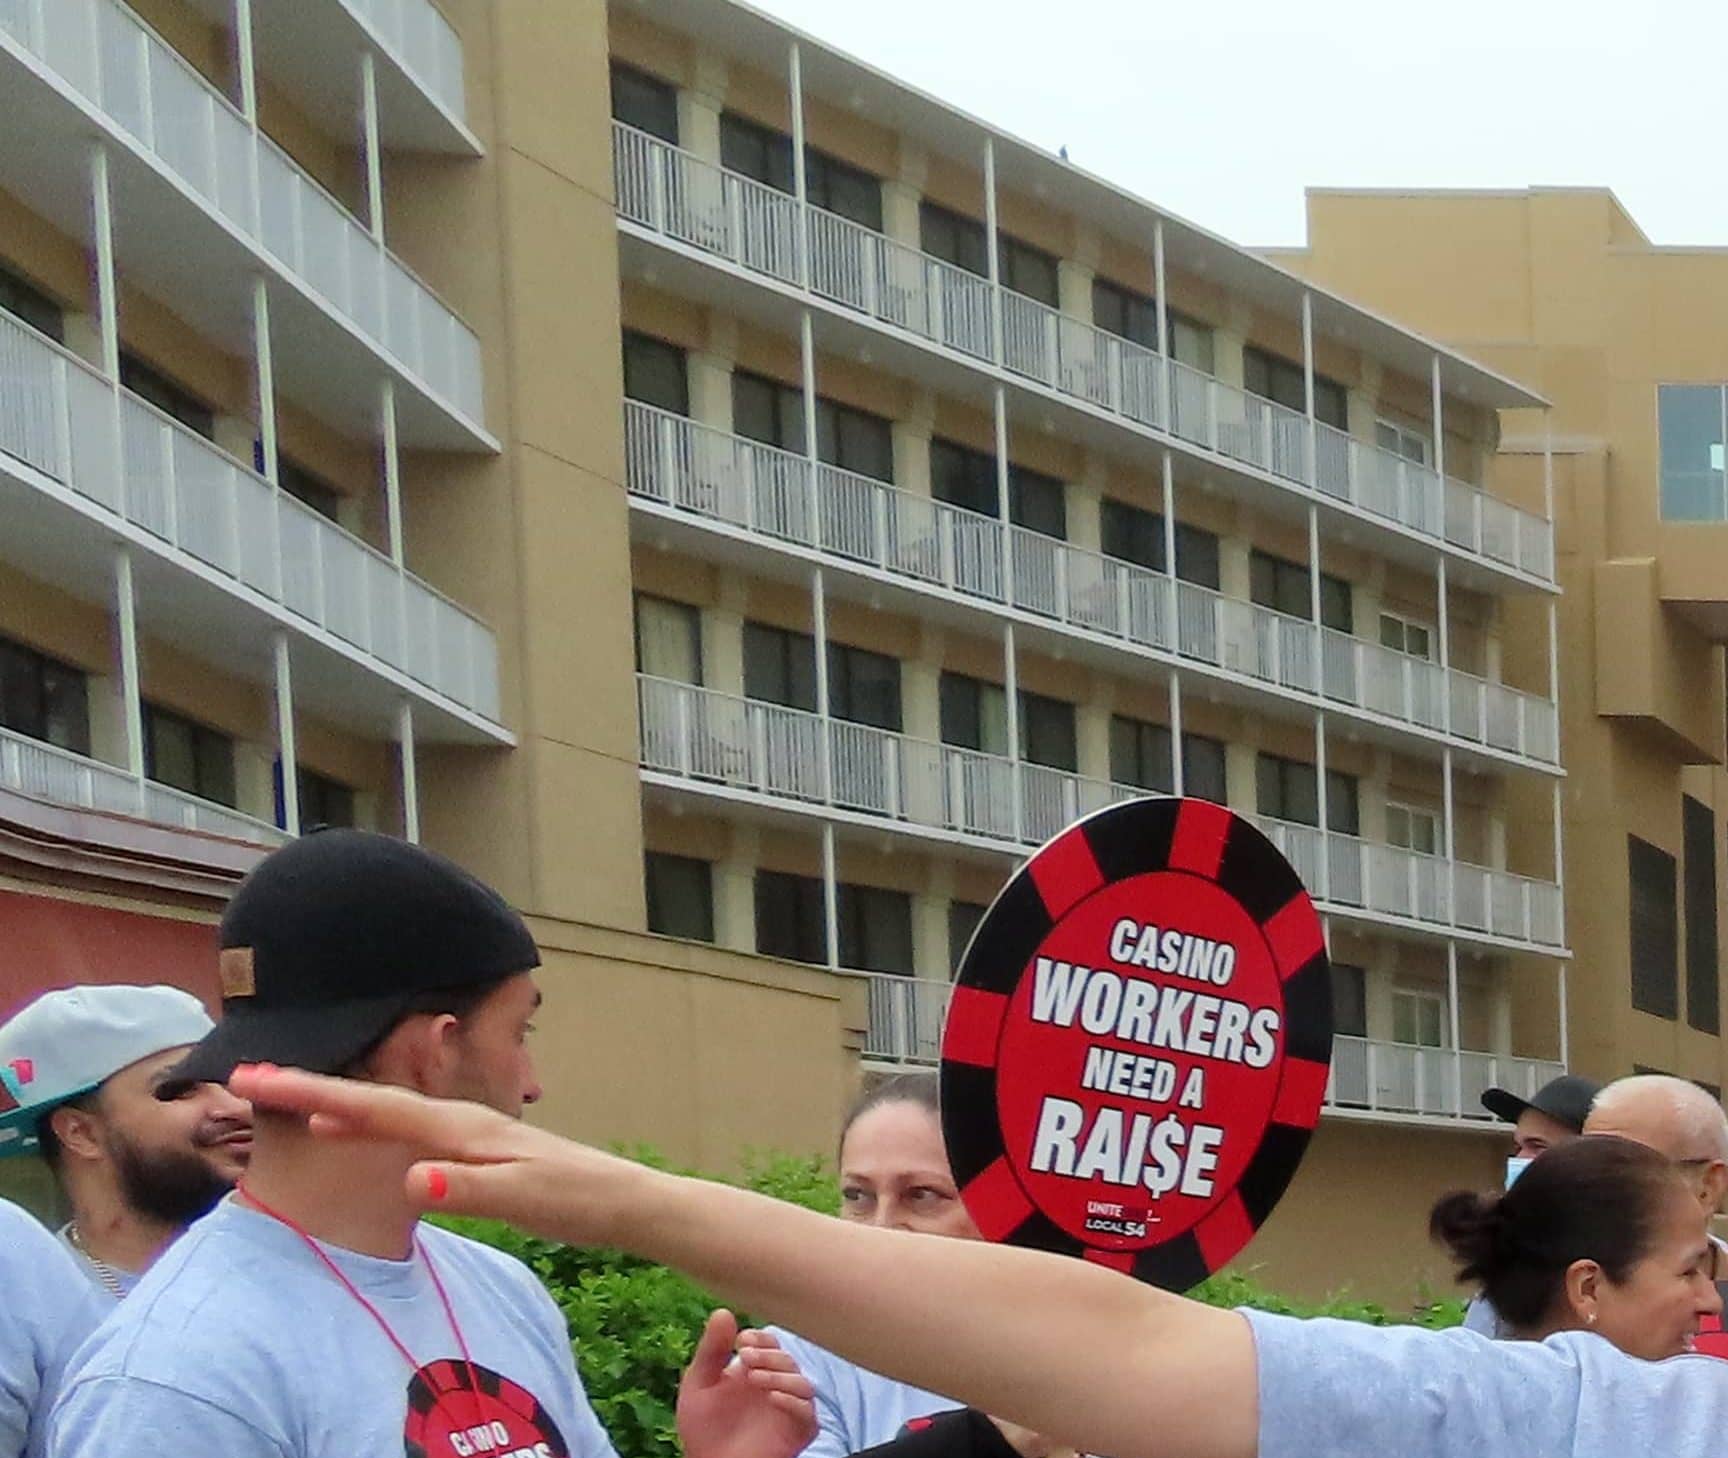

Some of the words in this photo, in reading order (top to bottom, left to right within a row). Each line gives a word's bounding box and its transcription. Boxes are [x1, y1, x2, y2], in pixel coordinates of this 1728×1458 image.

[1109, 918, 1236, 986] CASINO
[1031, 957, 1281, 1069] WORKERS
[1081, 1046, 1178, 1103] NEED
[1178, 1067, 1205, 1109] A
[1029, 1096, 1225, 1199] RAI$E
